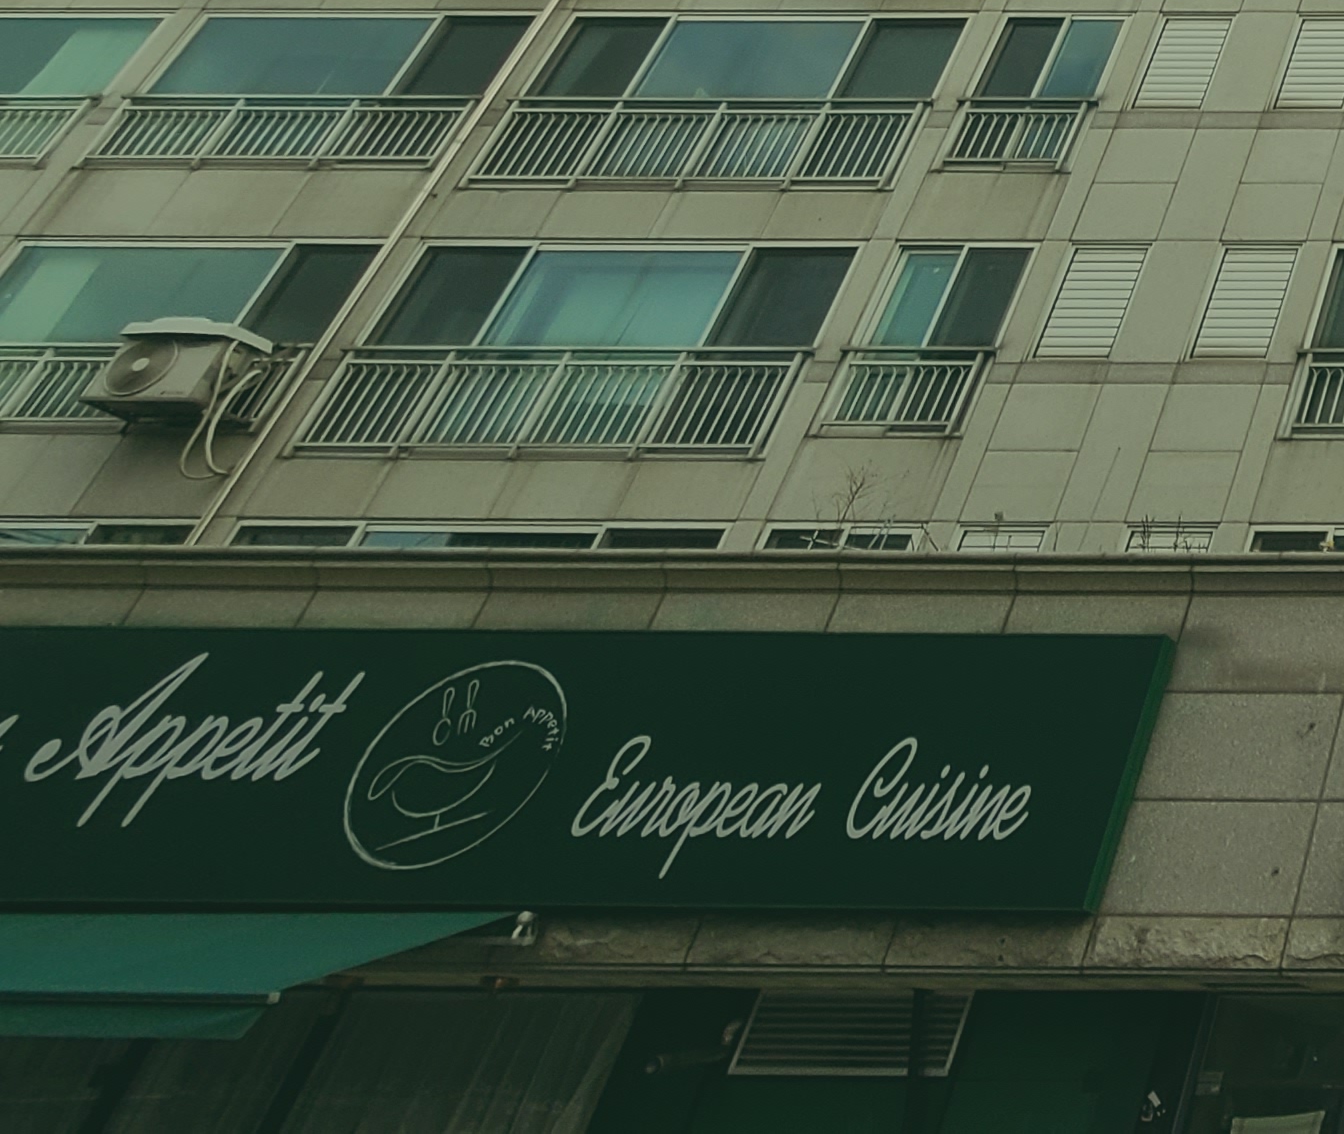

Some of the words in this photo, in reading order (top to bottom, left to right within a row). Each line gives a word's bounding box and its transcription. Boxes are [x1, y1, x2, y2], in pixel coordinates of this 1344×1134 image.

[24, 652, 366, 827] Appetit
[478, 717, 515, 748] Bon
[571, 735, 823, 878] European
[845, 737, 1030, 841] Cuisine
